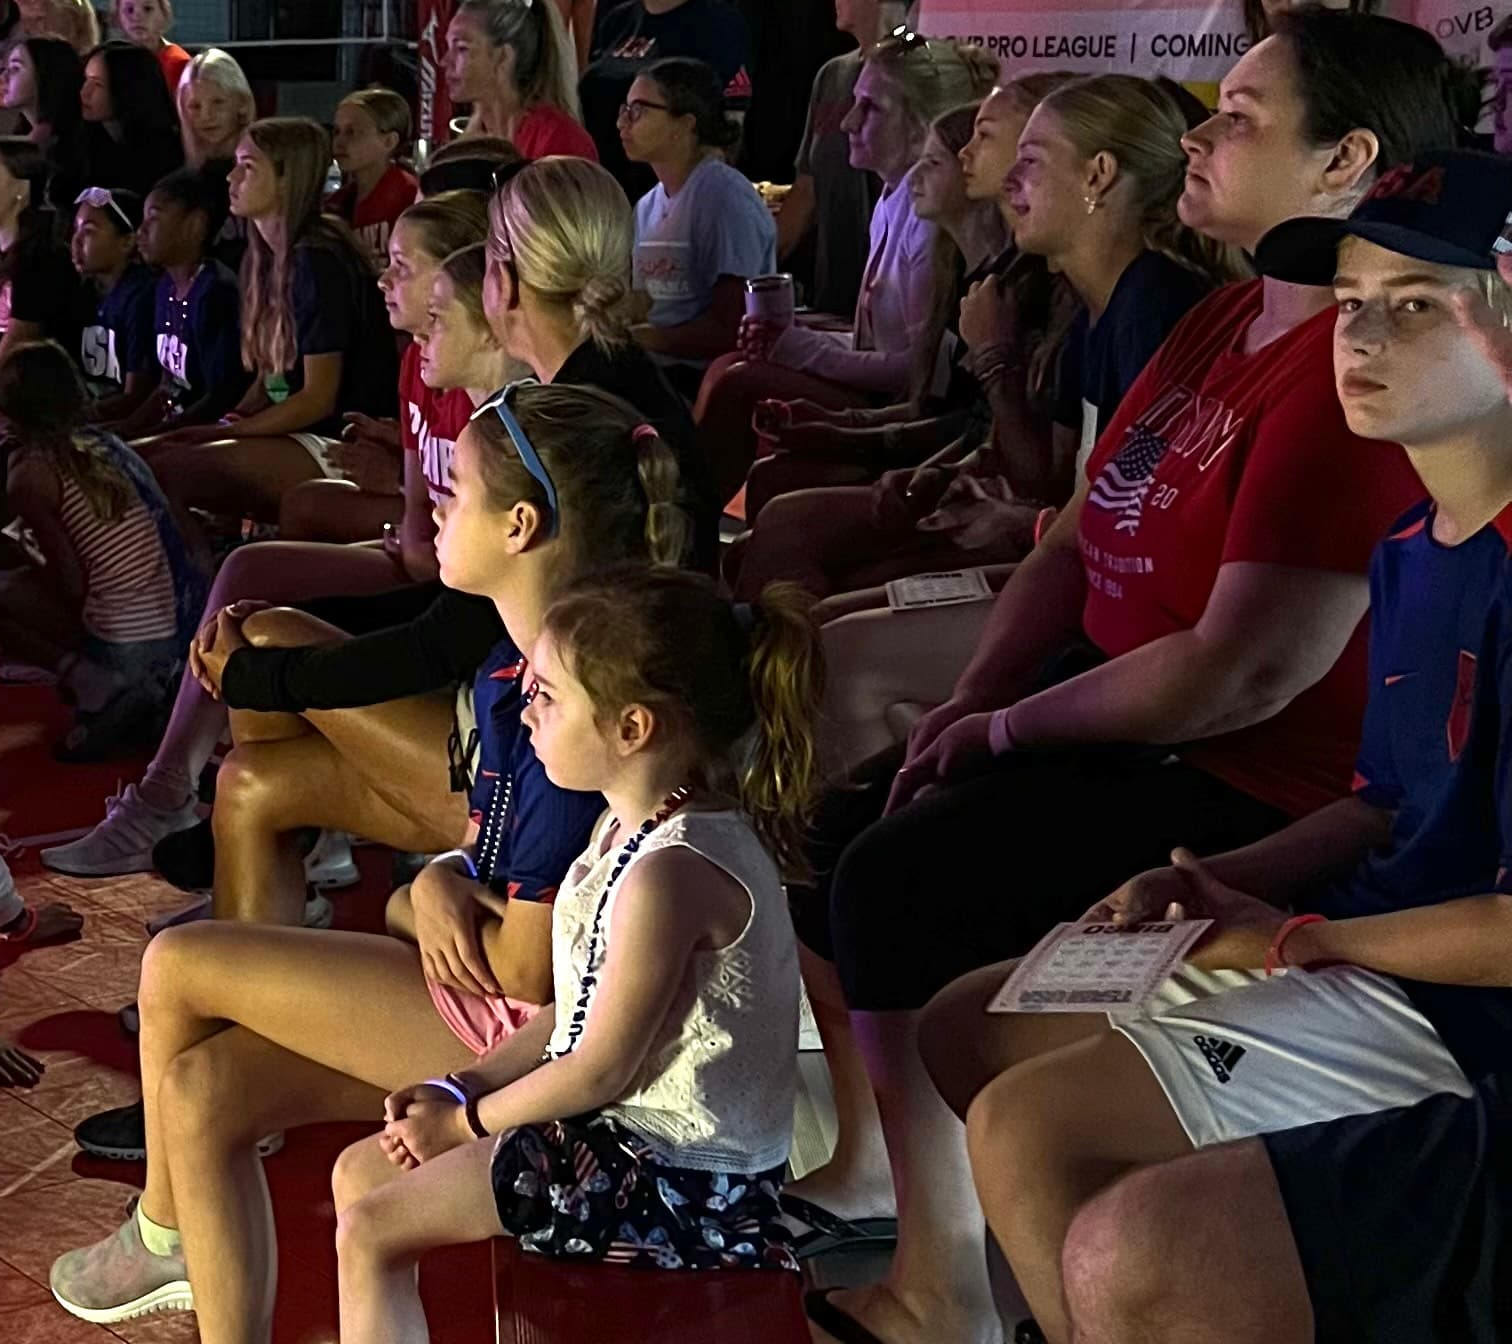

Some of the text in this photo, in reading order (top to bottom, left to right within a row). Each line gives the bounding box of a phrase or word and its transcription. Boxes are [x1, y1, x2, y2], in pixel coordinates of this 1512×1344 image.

[1428, 6, 1495, 39] OVB
[988, 36, 1028, 58] PRO
[1033, 36, 1117, 58] LEAGUE
[1151, 33, 1251, 57] COMING
